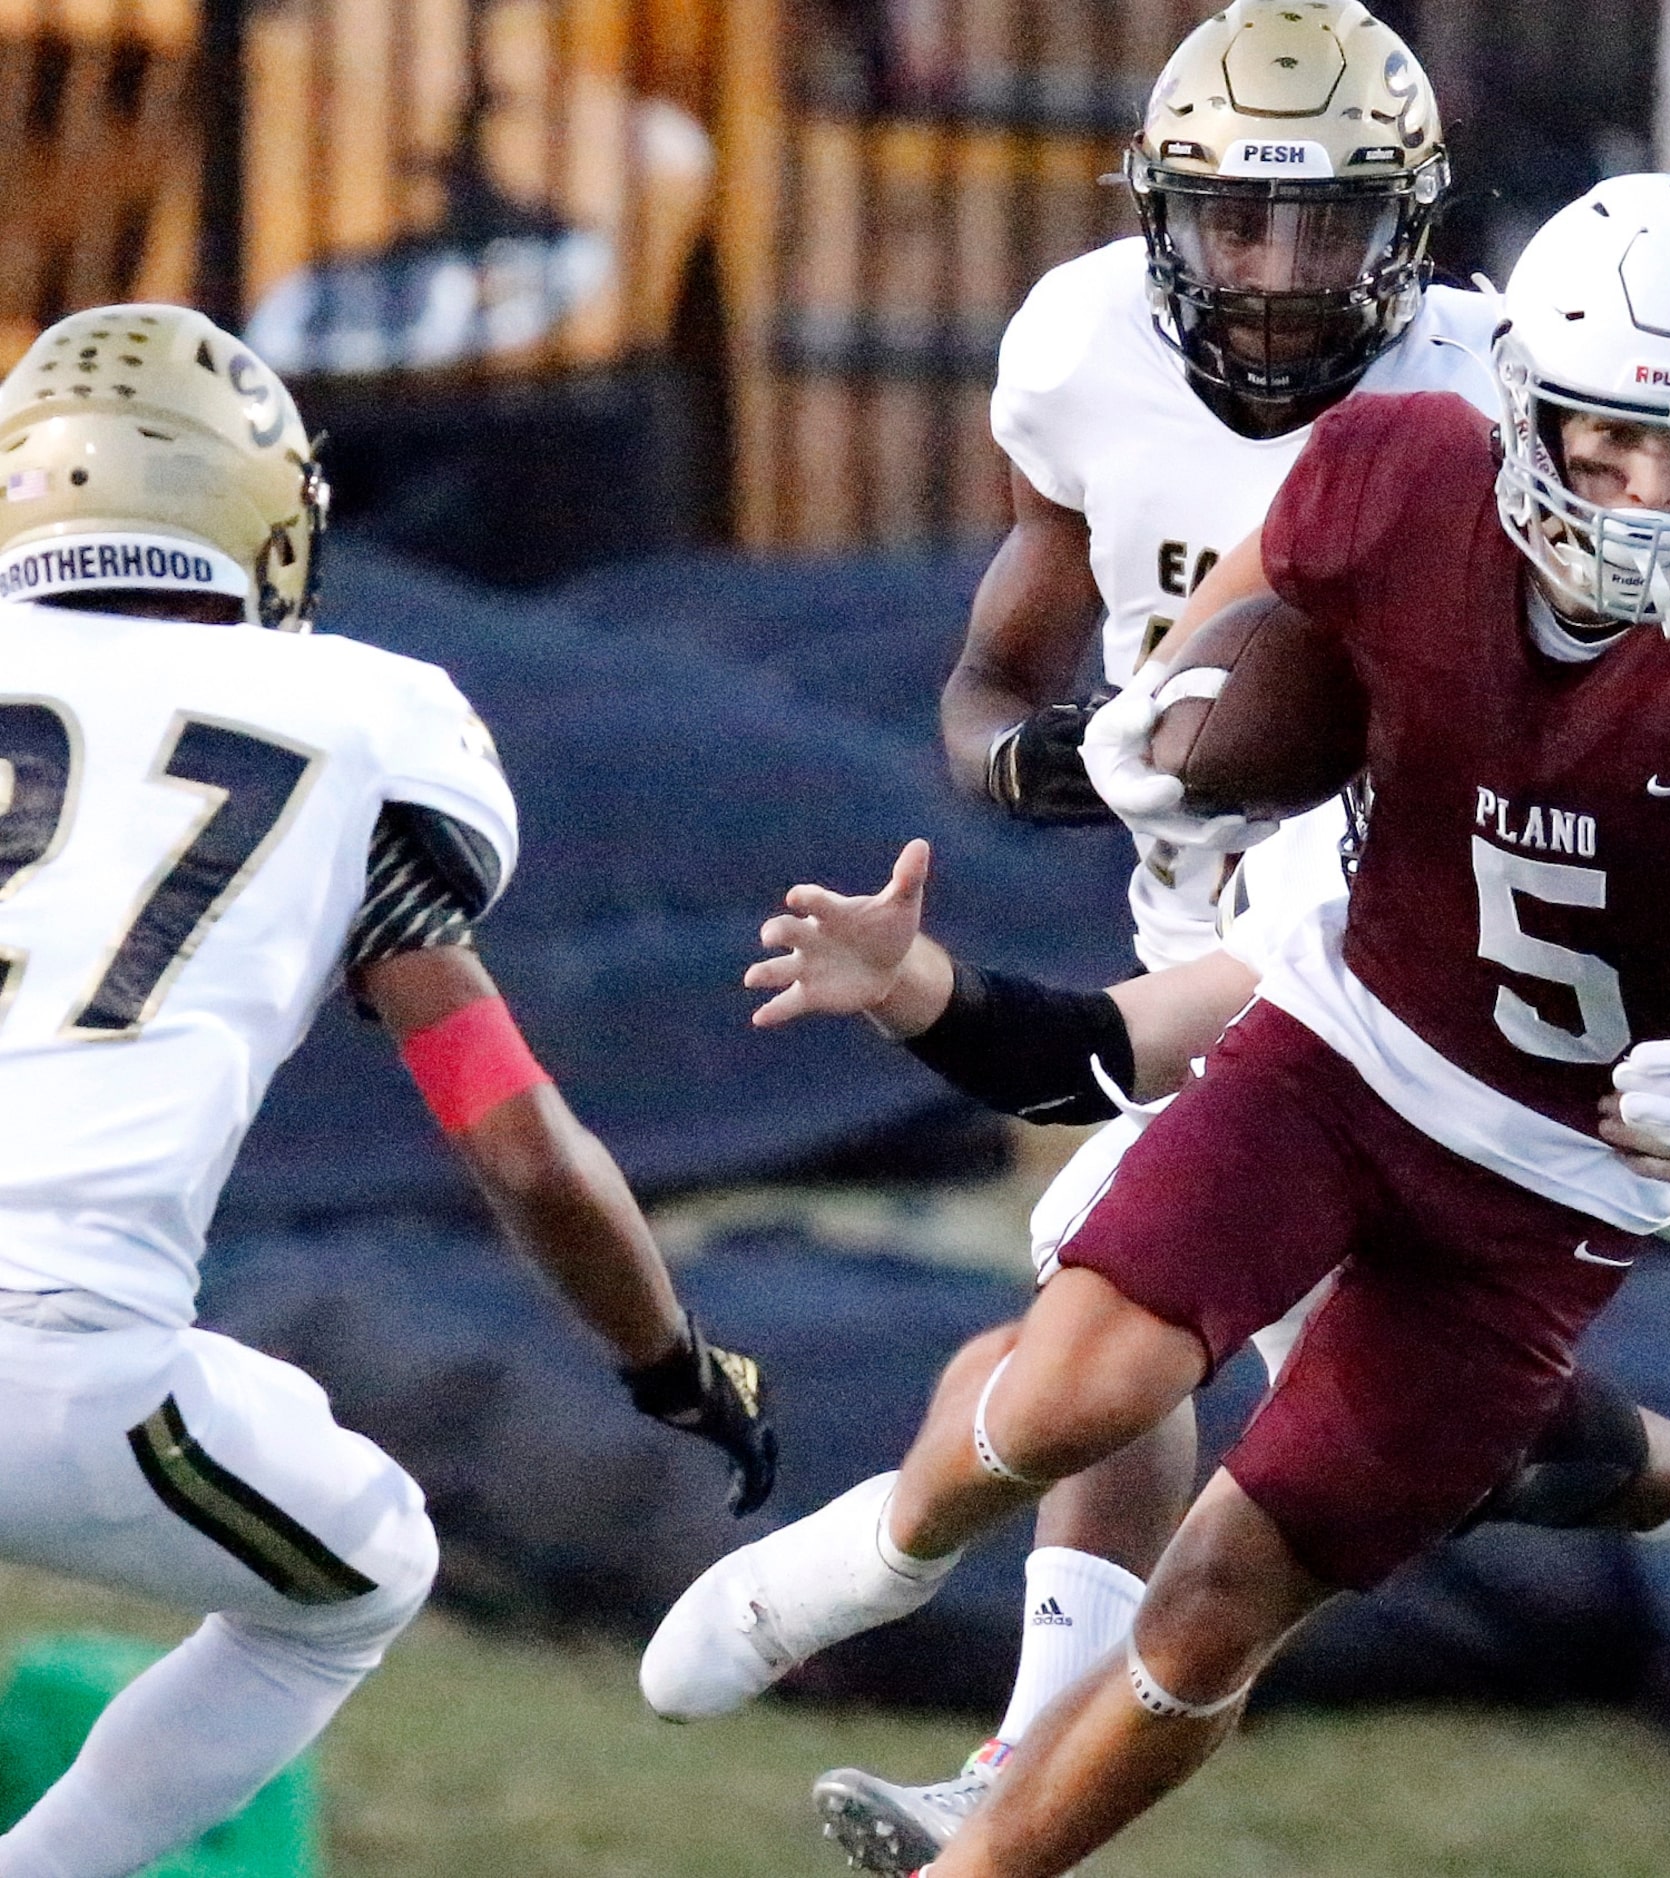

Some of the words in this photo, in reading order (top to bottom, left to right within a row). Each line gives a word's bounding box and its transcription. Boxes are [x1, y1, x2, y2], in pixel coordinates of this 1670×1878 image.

[1244, 145, 1305, 163] PESH
[1474, 785, 1597, 859] PLANO
[1471, 834, 1632, 1065] 5
